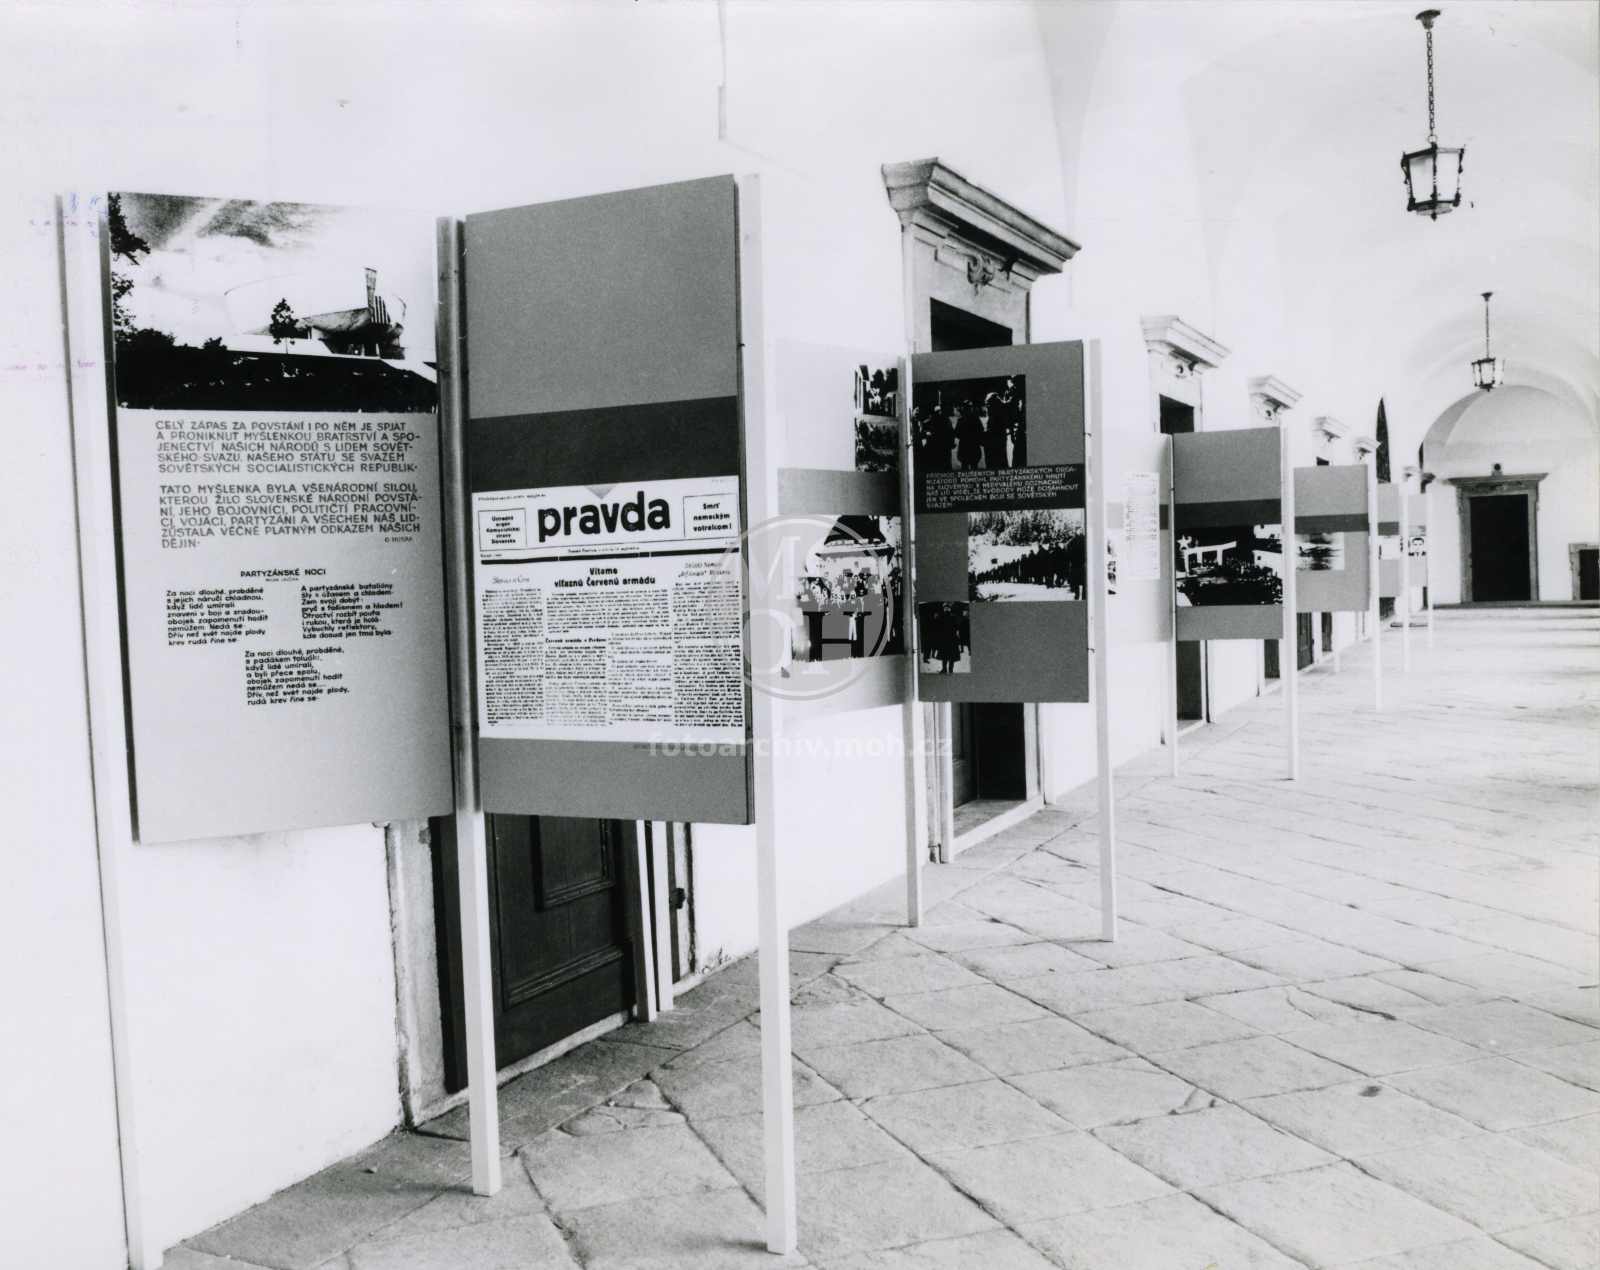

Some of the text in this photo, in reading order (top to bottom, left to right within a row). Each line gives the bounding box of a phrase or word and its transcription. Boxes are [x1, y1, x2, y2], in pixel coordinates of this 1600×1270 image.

[156, 420, 184, 429] CELÝ
[191, 420, 227, 430] ZÁPAS
[232, 422, 246, 430] ZA
[252, 420, 303, 430] POVSTÁNÍ
[334, 421, 356, 431] NĚM
[361, 423, 372, 431] JE
[377, 423, 406, 431] SPJAT
[157, 431, 420, 441] A PRONIKNUT MYŠLENKOU BRATRSTVÍ A SPO-
[157, 441, 413, 451] JENECTVÍ NAŠICH NÁRODŮ S LIDEM SOVĚT-
[158, 452, 198, 462] SKÉHO
[247, 452, 293, 461] NAŠEHO
[300, 452, 334, 461] STÁTU
[342, 453, 354, 461] SE
[361, 453, 404, 461] SVAZEM
[159, 463, 240, 472] SOVĚTSKÝCH
[247, 463, 354, 472] SOCIALISTICKÝCH
[198, 484, 260, 493] MYŠLENKA
[267, 485, 296, 493] BYLA
[302, 483, 377, 492] VŠENÁRODNÍ
[383, 483, 417, 492] SILOU,
[160, 492, 422, 504] KTEROU ŽILO SLOVENSKÉ NÁRODNÍ POVSTÁ-
[179, 507, 210, 515] JEHO
[217, 505, 288, 515] BOJOVNÍCI,
[292, 503, 348, 513] POLITIČTÍ
[354, 502, 416, 512] PRACOVNÍ-
[181, 516, 226, 526] VOJÁCI,
[231, 515, 295, 525] PARTYZÁNI
[313, 514, 367, 523] VŠECHEN
[374, 513, 395, 522] NÁŠ
[538, 490, 671, 543] pravda
[162, 523, 420, 537] ZŮSTALA VĚČNĚ PLATNÝM ODKAZEM NAŠICH
[241, 568, 299, 577] PARTYZÁNSKÉ
[554, 578, 583, 587] víťaznú
[586, 576, 619, 588] Červenú
